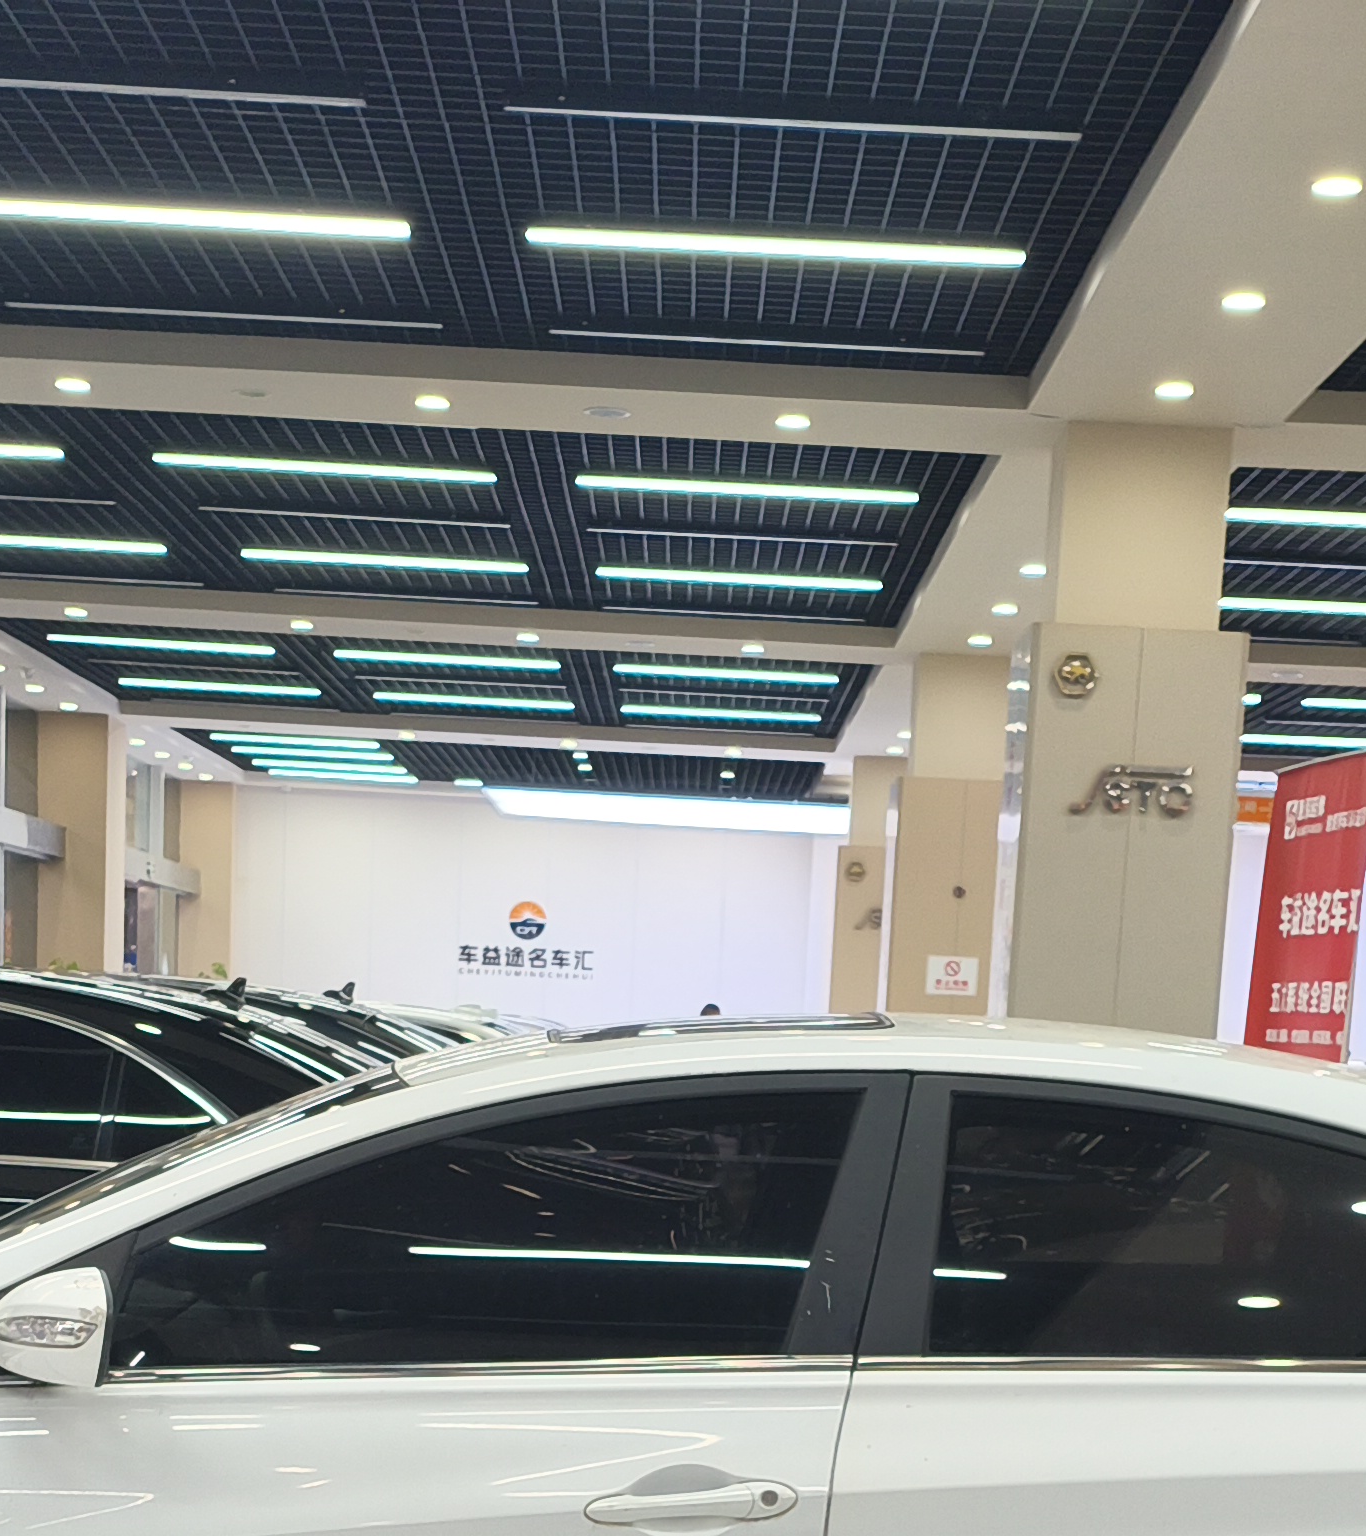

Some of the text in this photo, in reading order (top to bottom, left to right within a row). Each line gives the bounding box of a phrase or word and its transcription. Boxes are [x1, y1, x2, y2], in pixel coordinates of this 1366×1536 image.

[458, 945, 594, 971] 车益途名车汇
